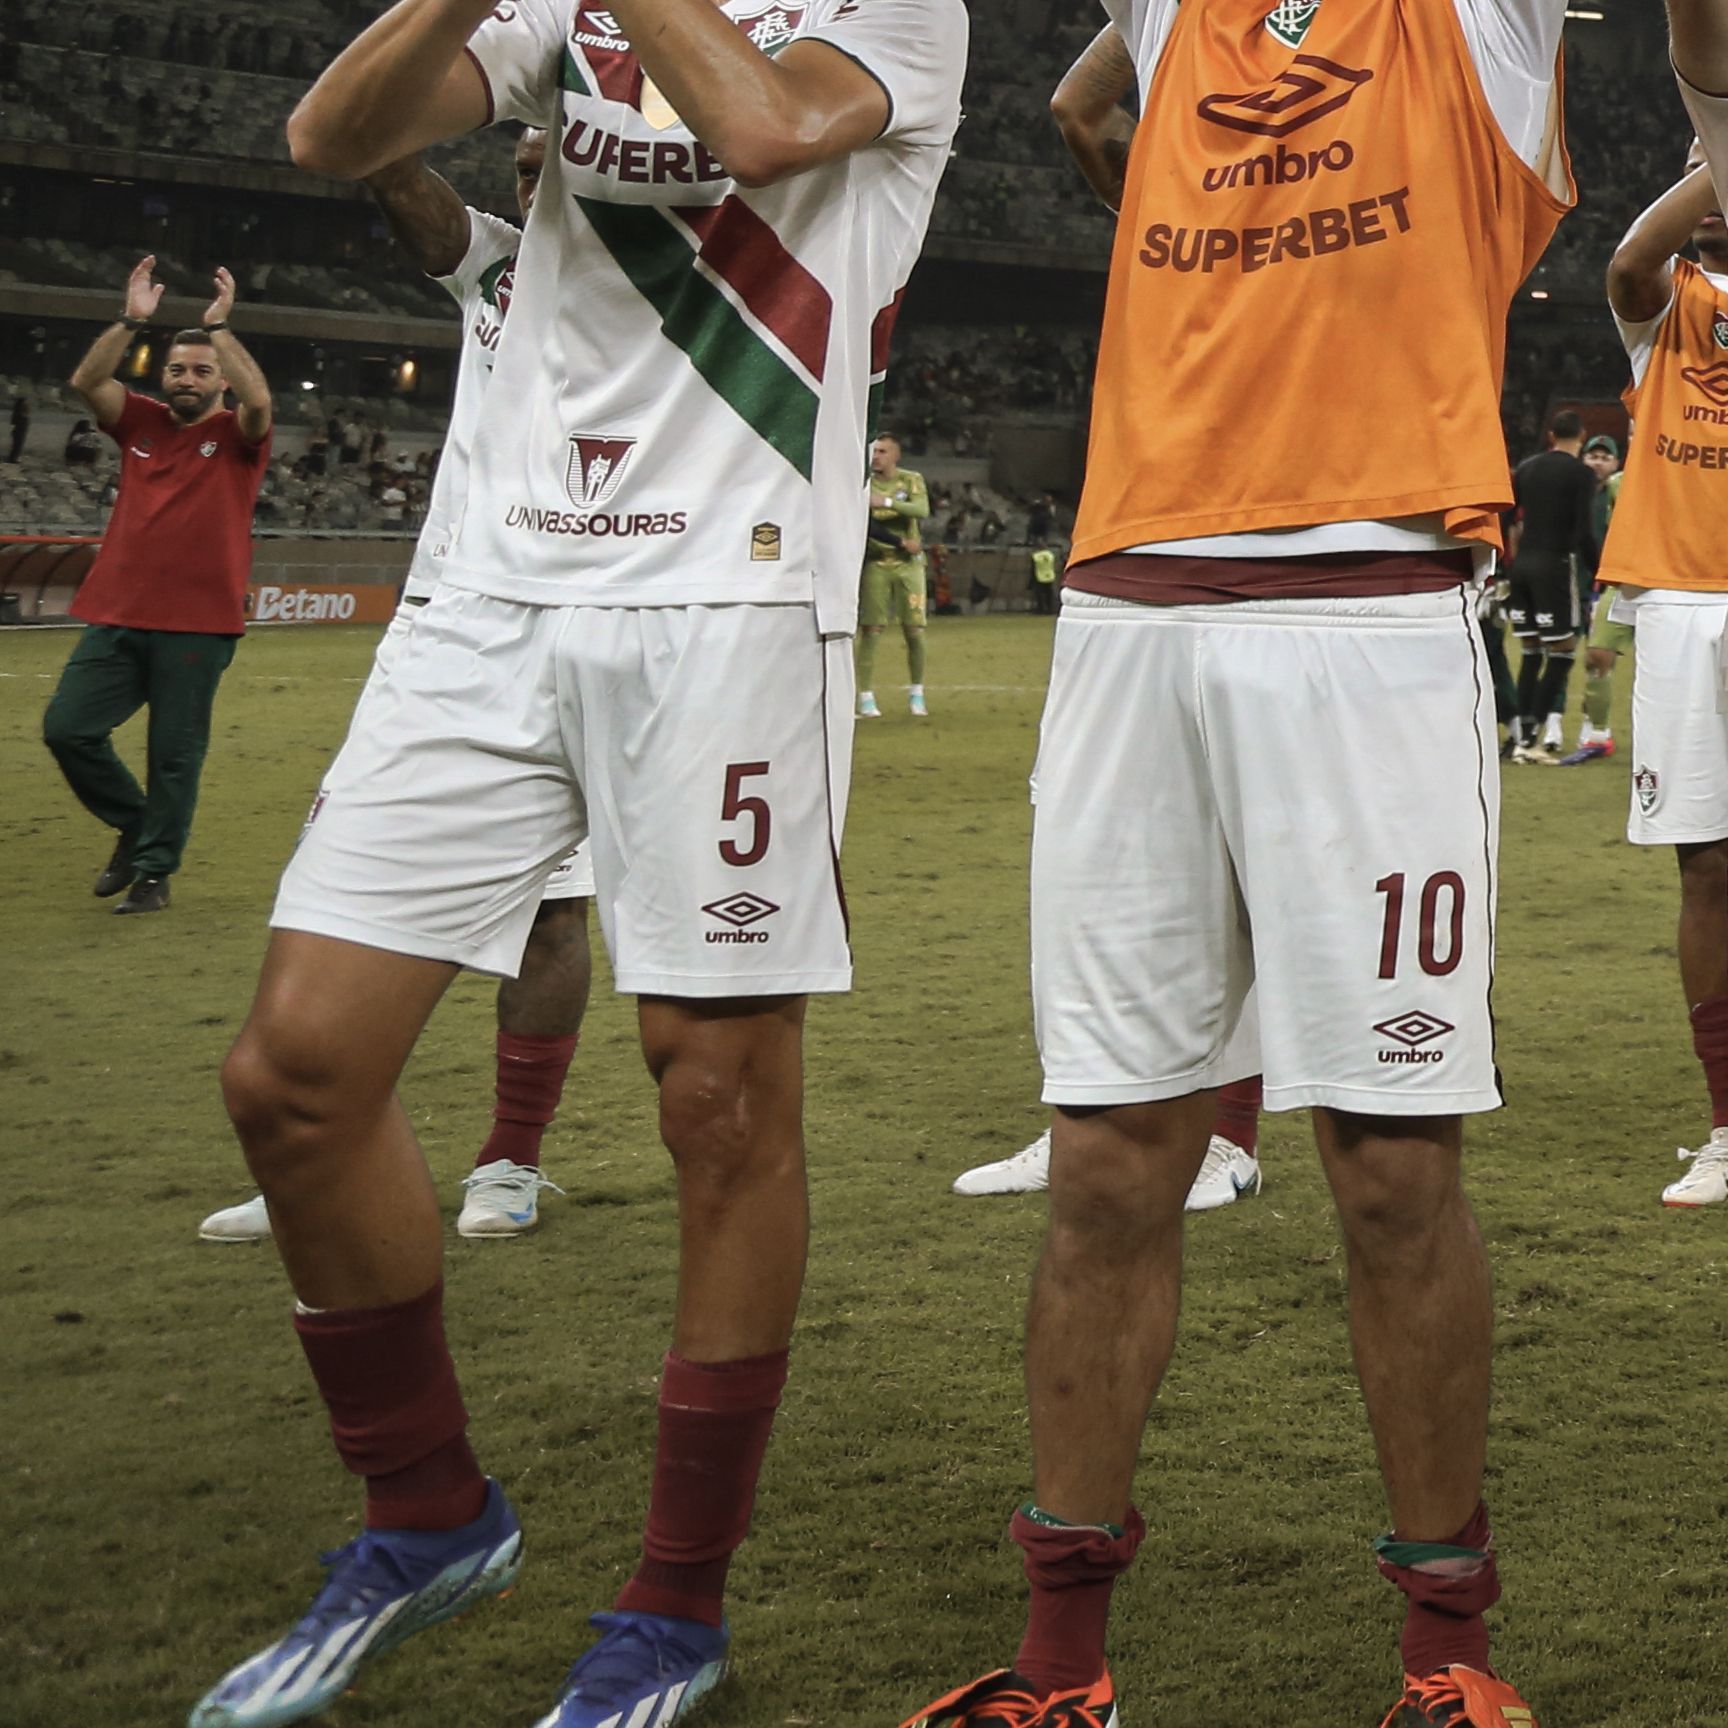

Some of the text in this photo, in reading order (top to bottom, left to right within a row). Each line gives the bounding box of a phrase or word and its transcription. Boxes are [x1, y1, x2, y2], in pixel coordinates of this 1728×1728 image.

[574, 30, 630, 52] umbro
[1202, 139, 1354, 192] umbro
[1139, 186, 1413, 274] SUPERBET
[255, 586, 356, 621] Betano
[718, 761, 772, 869] 5
[704, 928, 770, 945] umbro
[1375, 870, 1467, 980] 10
[1378, 1047, 1444, 1065] umbro
